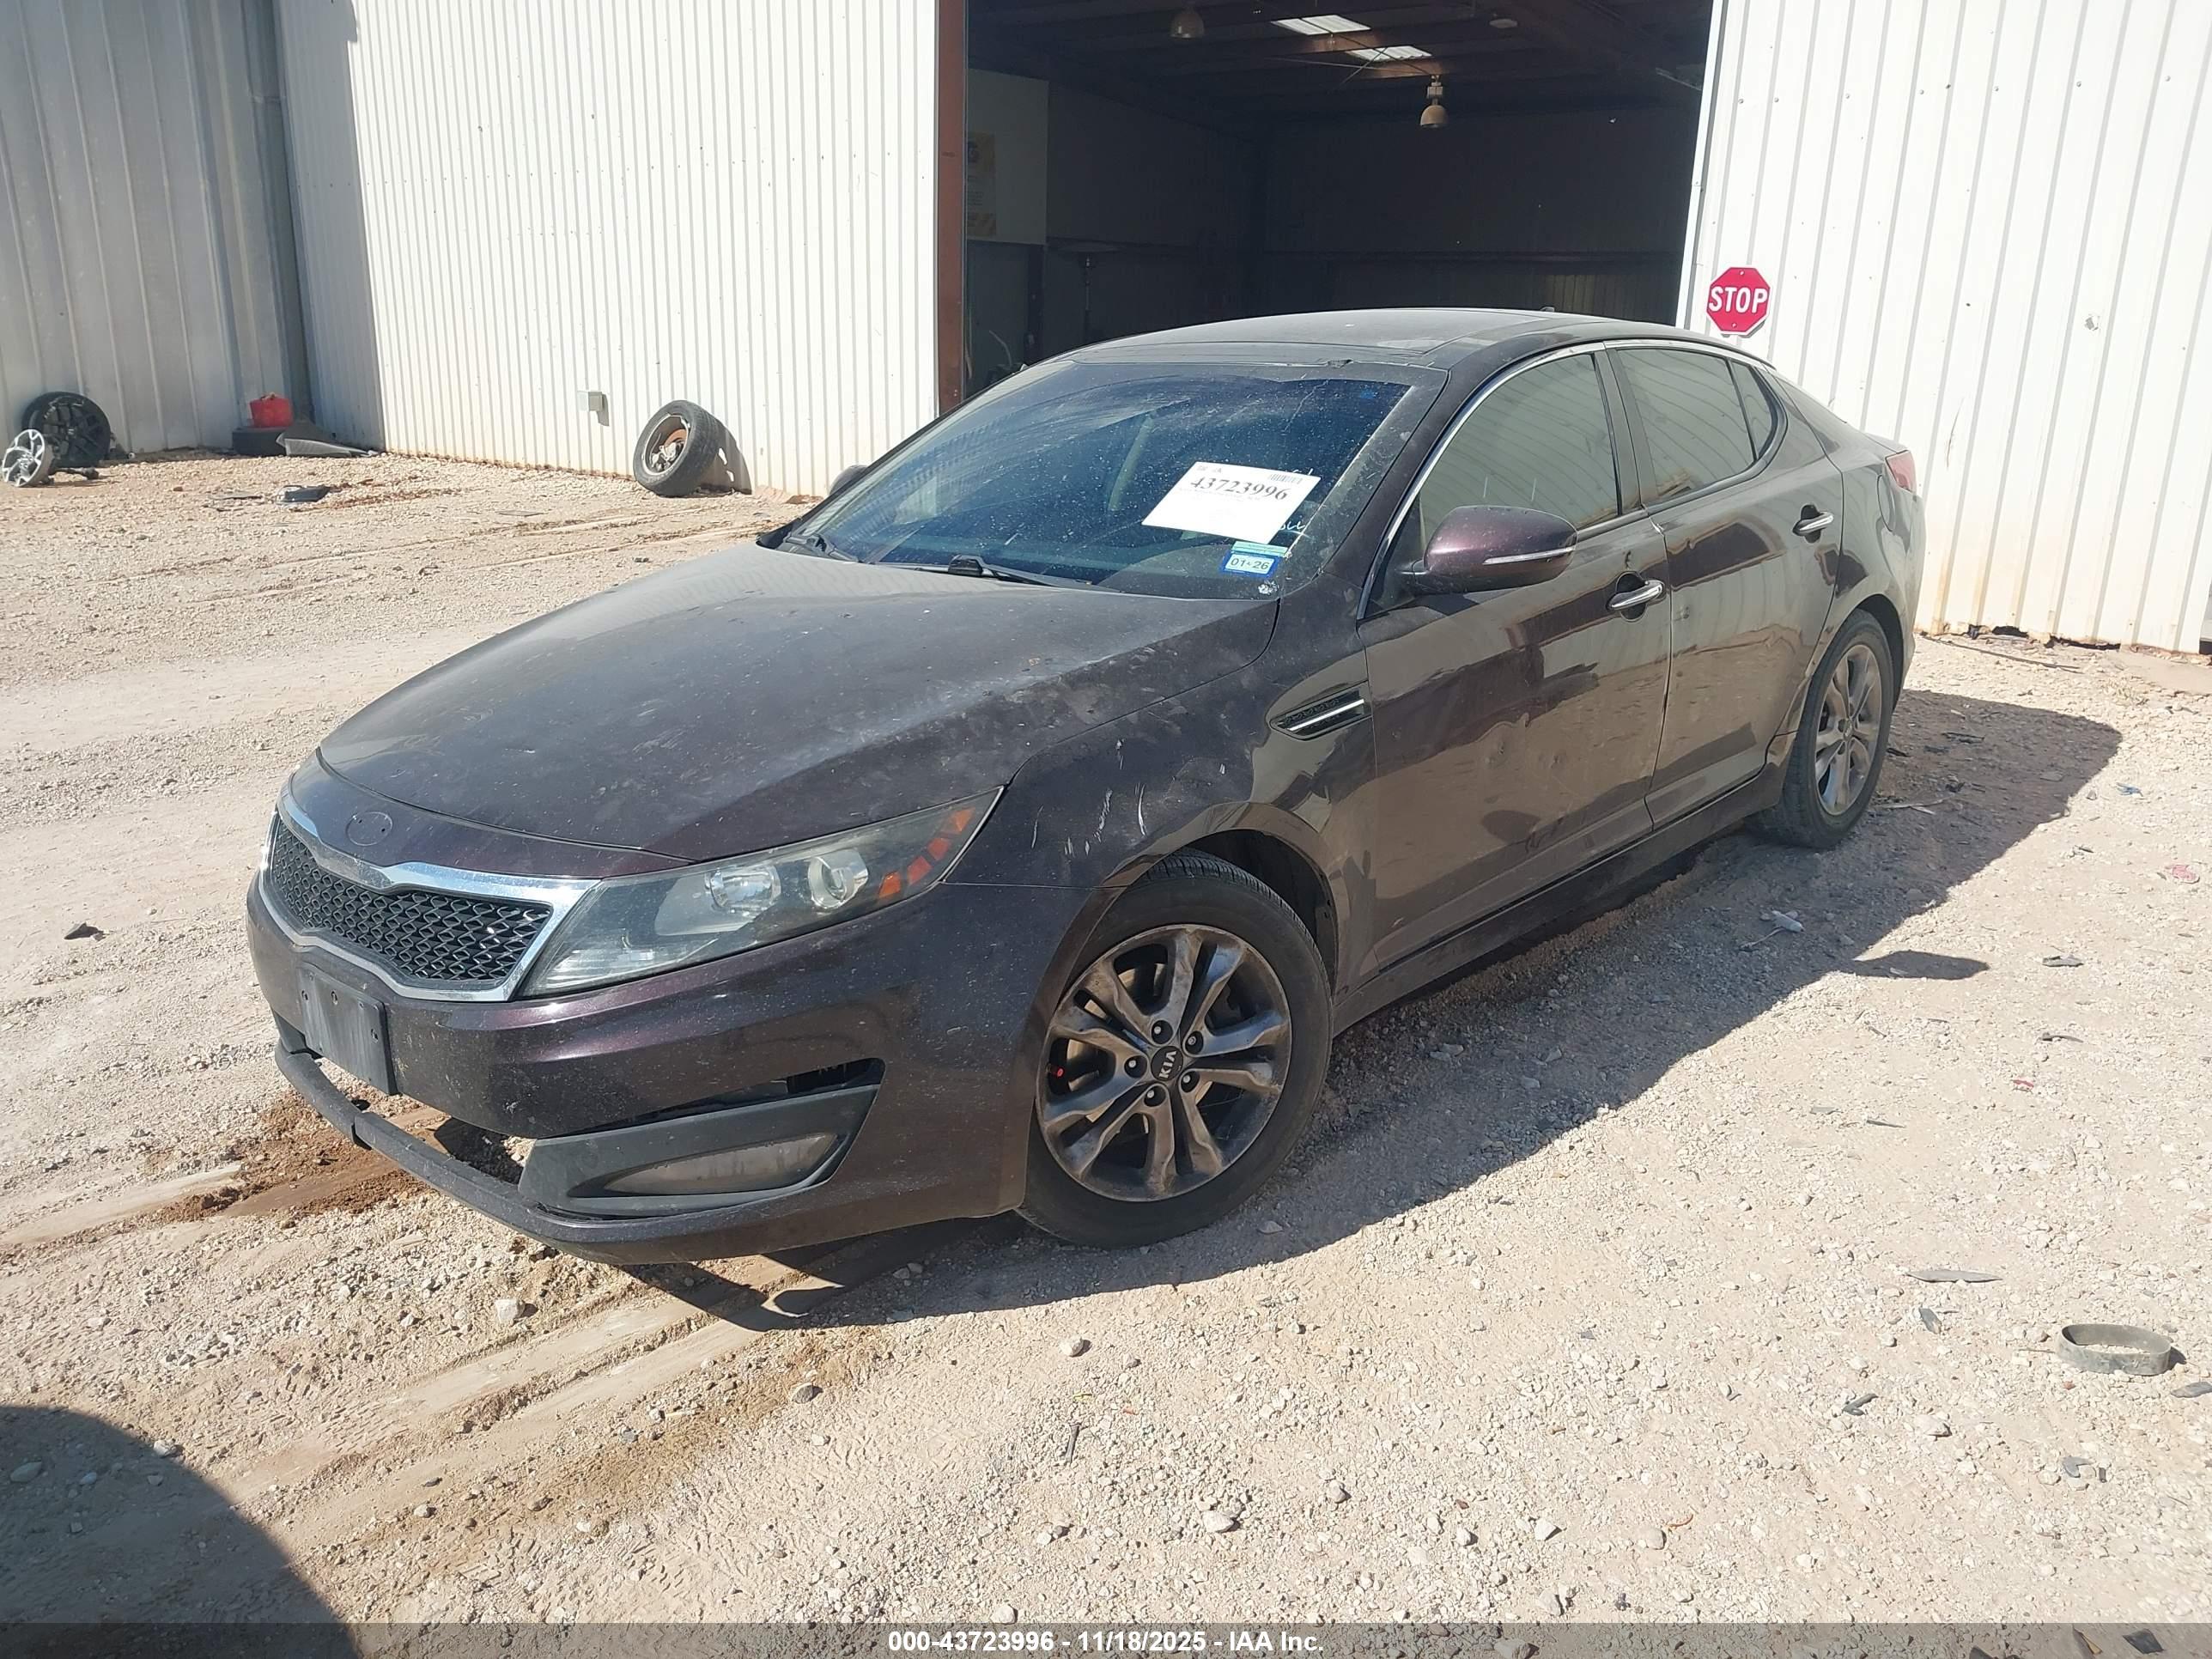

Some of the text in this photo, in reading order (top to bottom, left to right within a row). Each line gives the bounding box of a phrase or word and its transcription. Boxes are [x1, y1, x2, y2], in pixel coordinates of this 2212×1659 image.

[1708, 286, 1768, 313] STOP
[1190, 477, 1291, 500] 43723996
[1158, 1050, 1177, 1079] KIA
